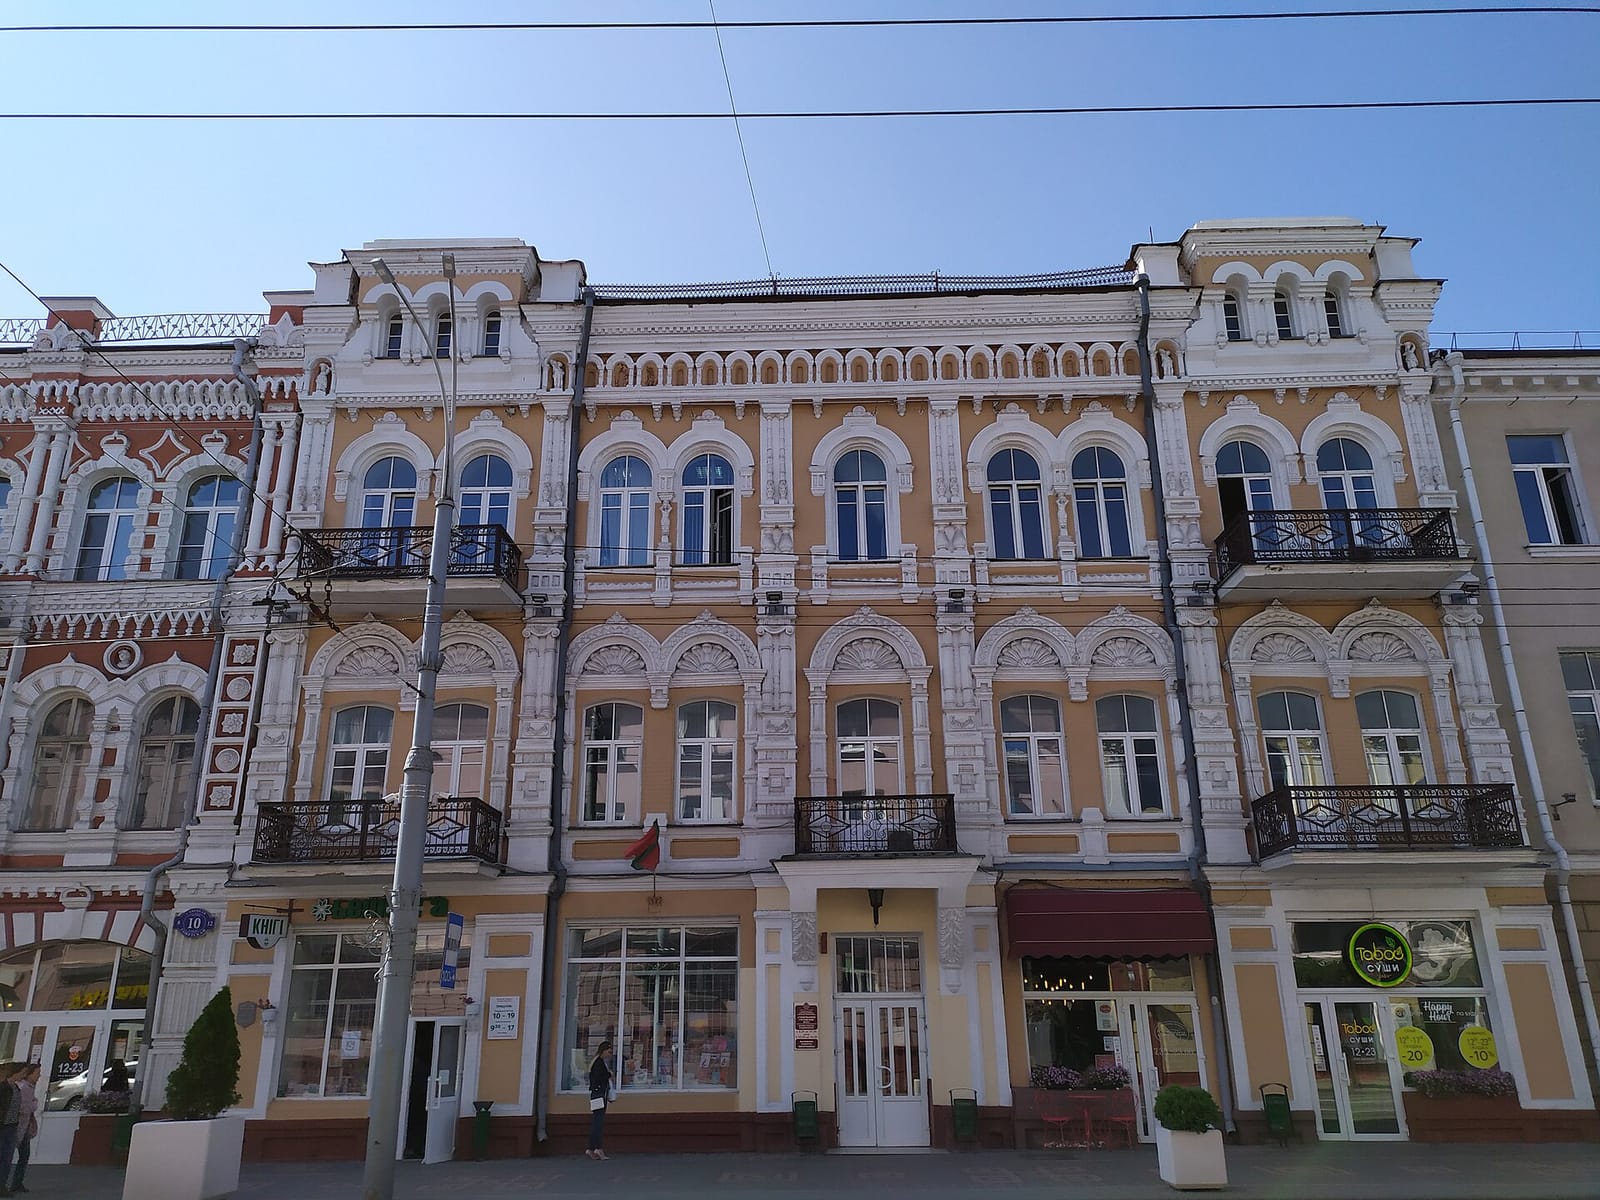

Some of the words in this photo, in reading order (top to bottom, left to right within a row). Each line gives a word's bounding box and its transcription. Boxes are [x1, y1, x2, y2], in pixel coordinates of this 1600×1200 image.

[188, 917, 202, 930] 10
[253, 919, 284, 935] КНІГІ
[1355, 942, 1404, 961] Taboo
[1423, 1001, 1453, 1014] Happy
[1428, 1011, 1452, 1022] Hour
[58, 1062, 84, 1073] 12-23
